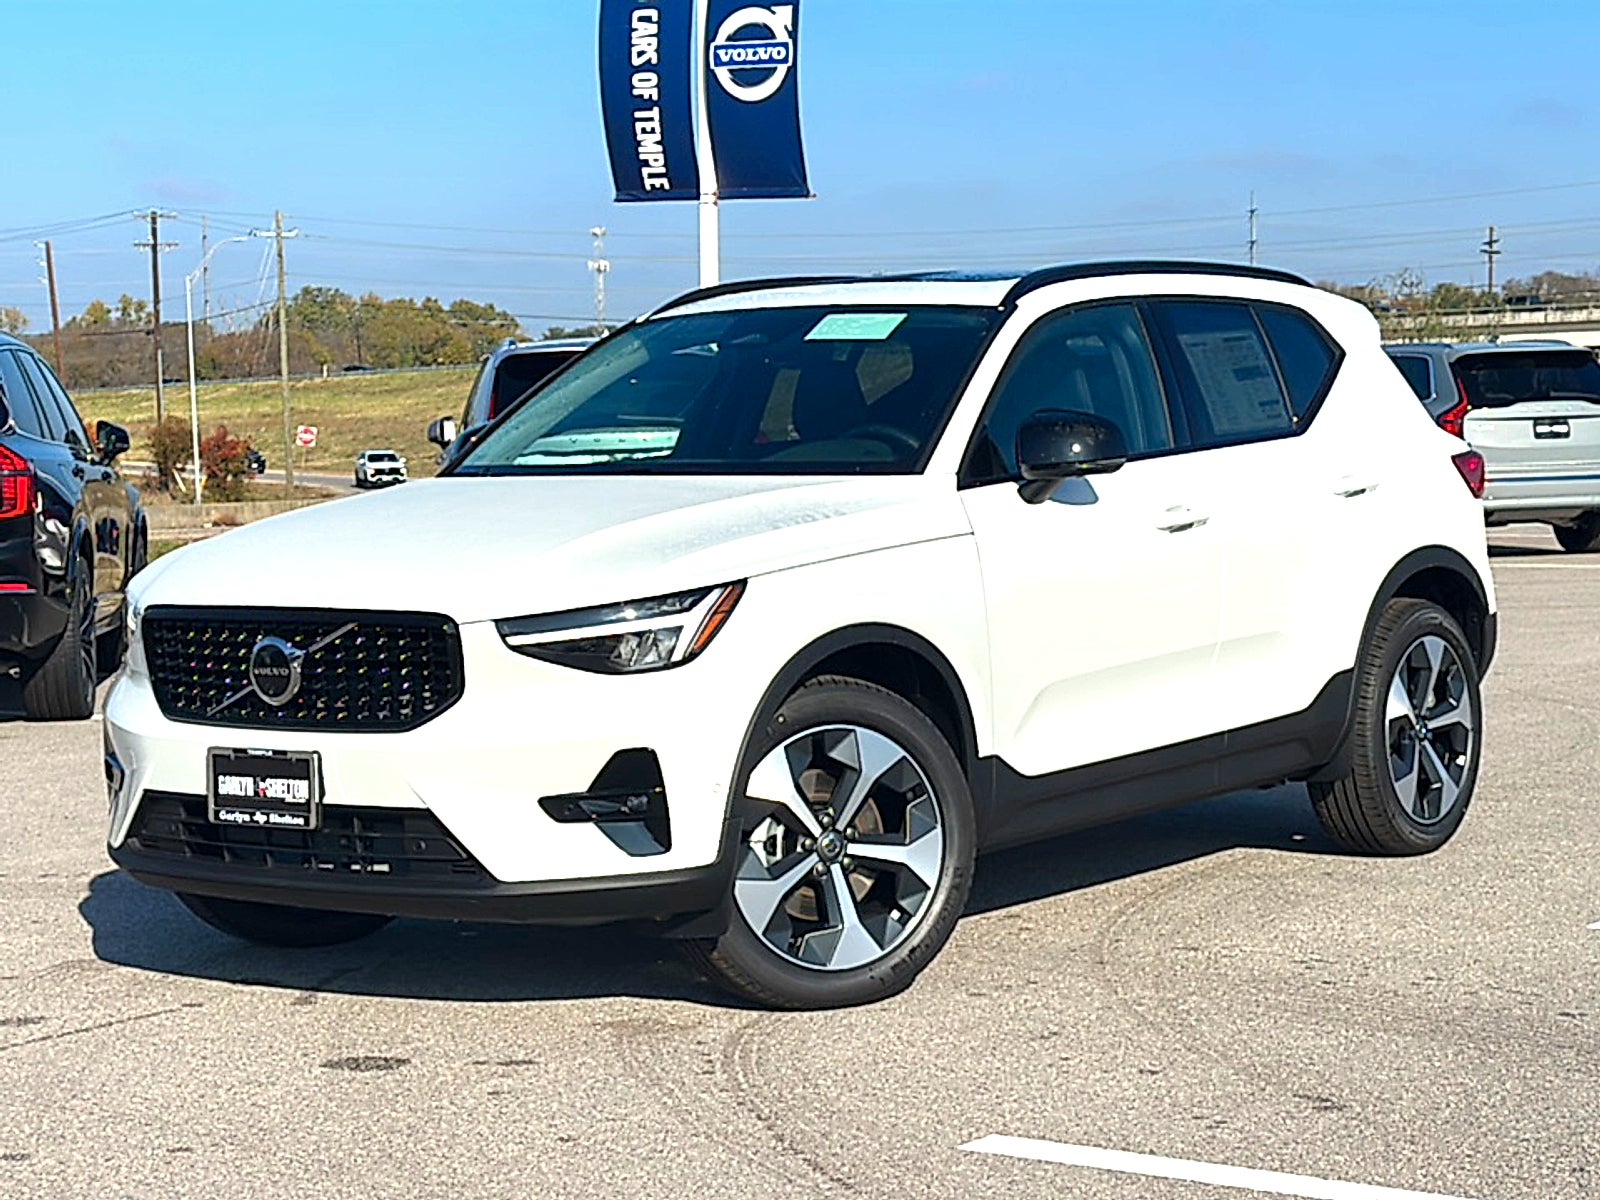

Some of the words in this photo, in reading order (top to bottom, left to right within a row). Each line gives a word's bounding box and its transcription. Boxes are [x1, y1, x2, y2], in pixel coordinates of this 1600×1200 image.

[631, 8, 659, 67] CARS
[715, 47, 787, 62] VOLVO
[631, 72, 659, 101] OF
[633, 106, 670, 191] TEMPLE
[253, 667, 290, 676] VOLVO
